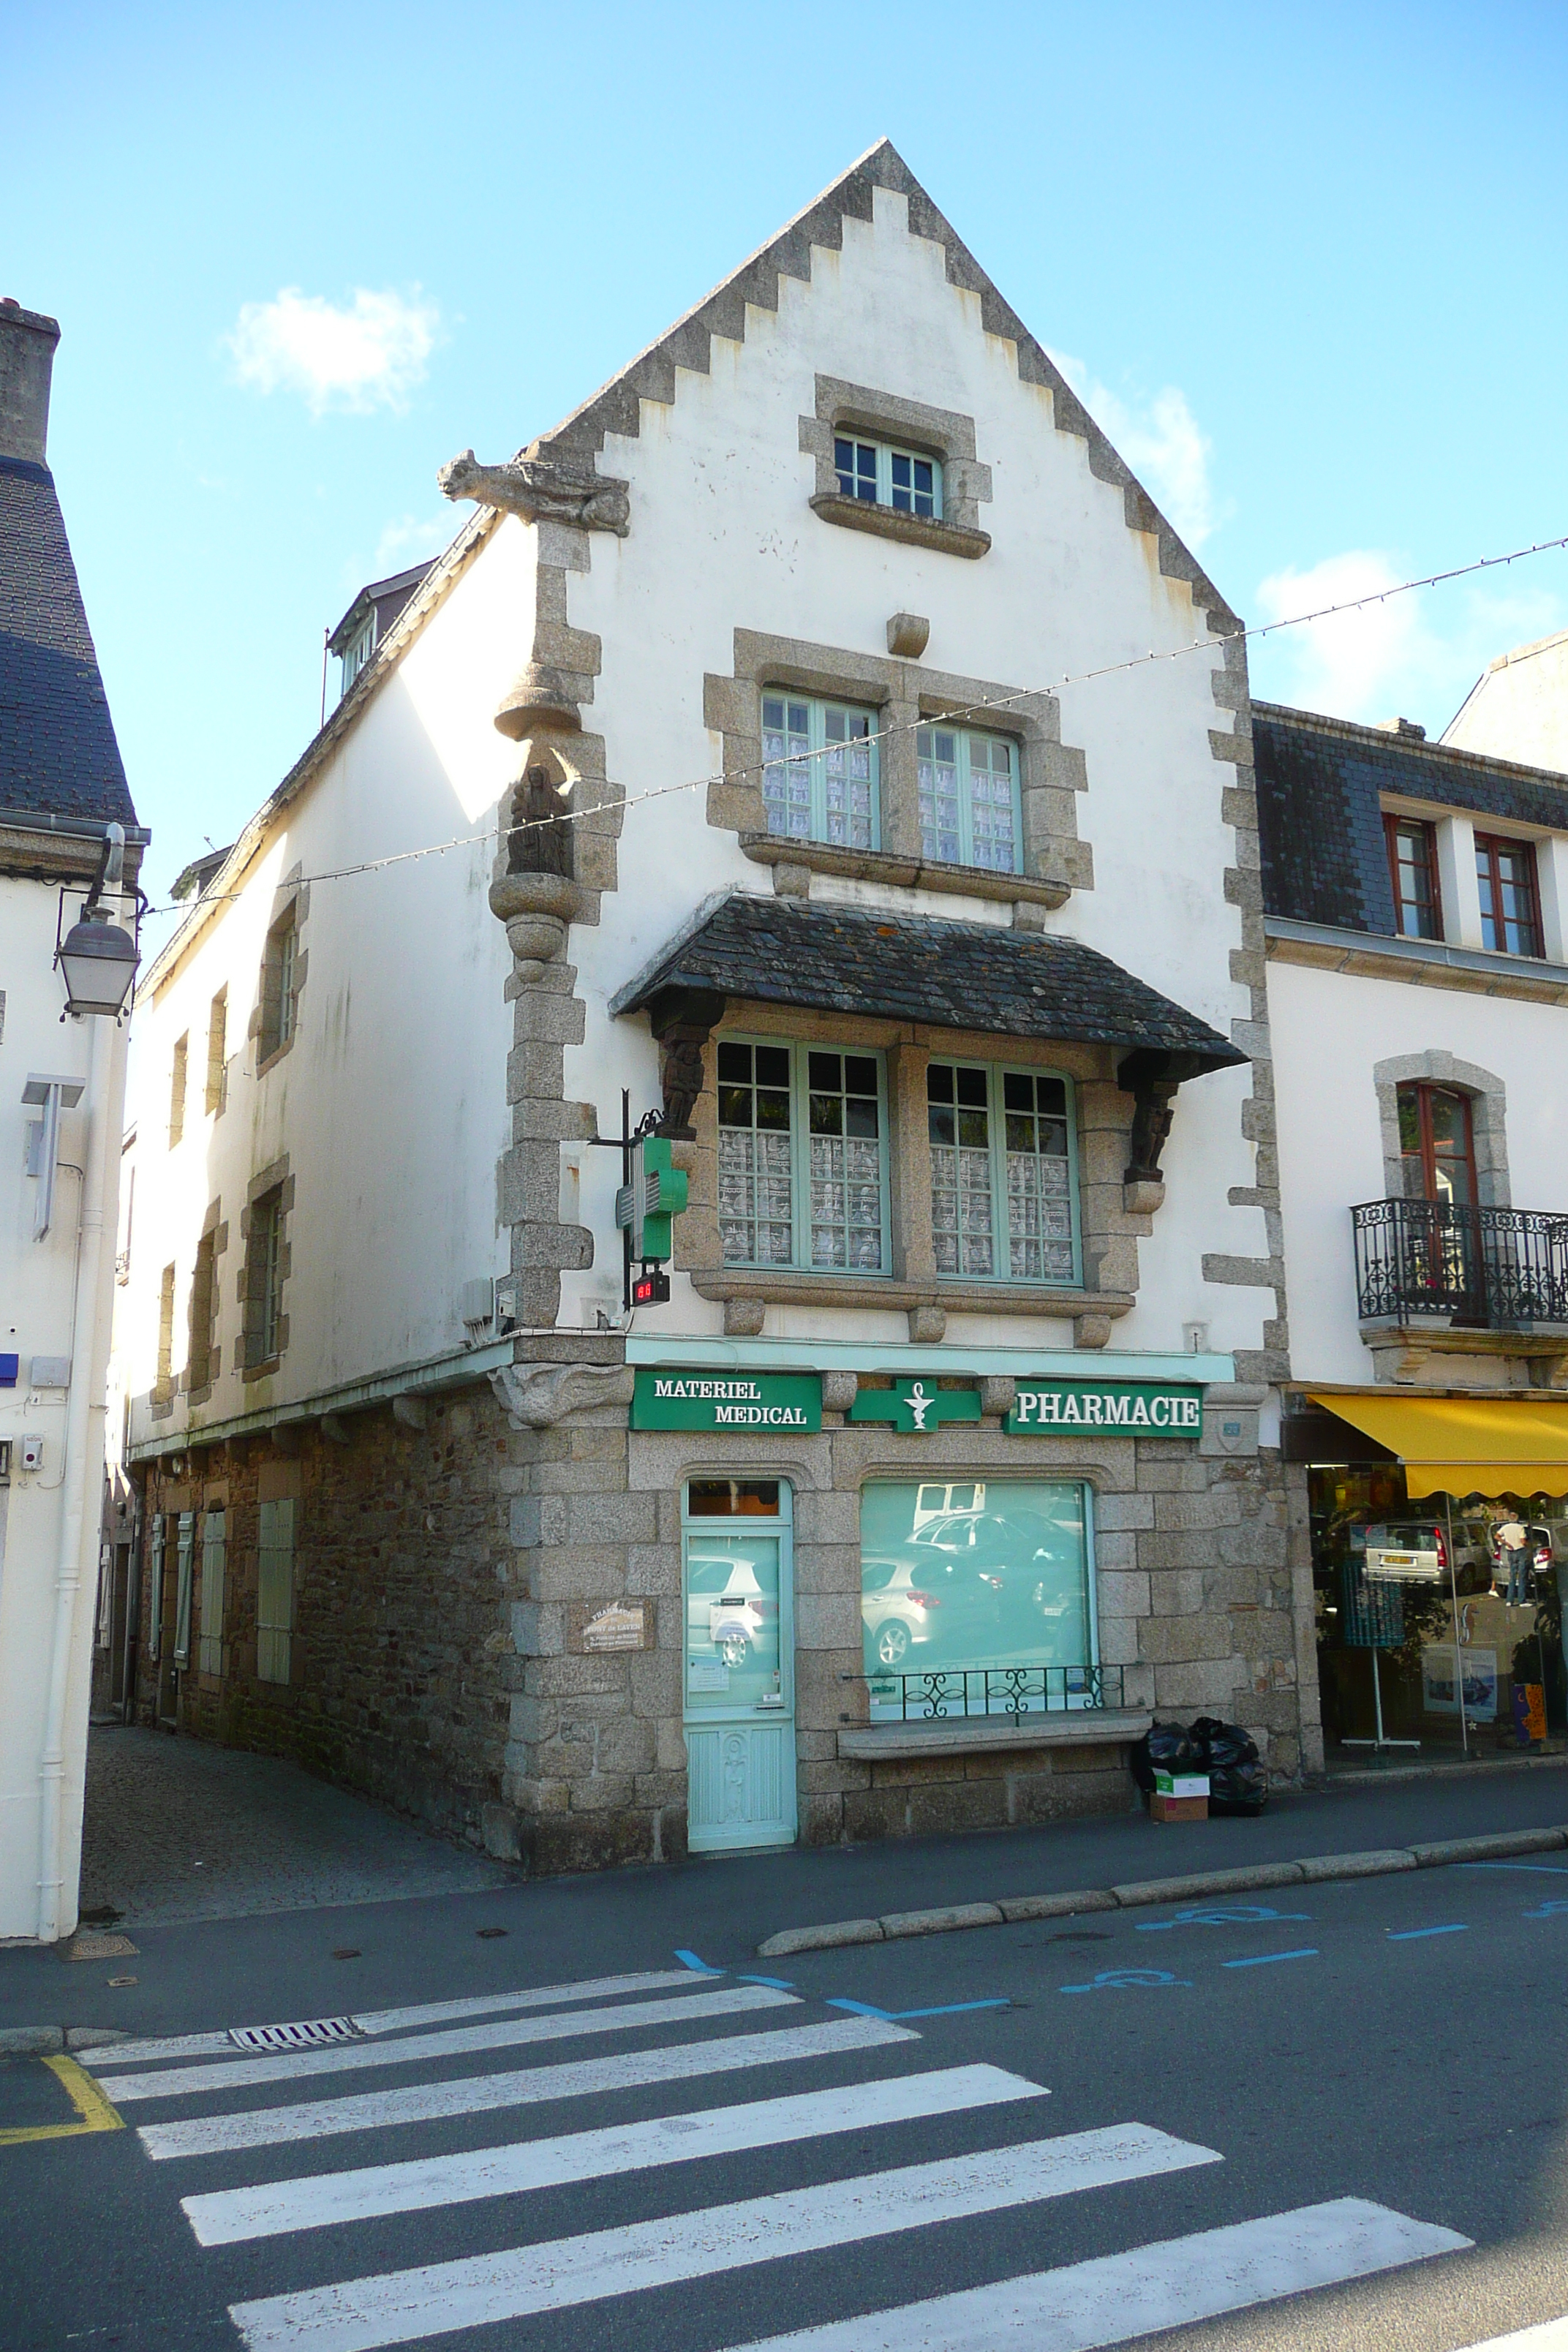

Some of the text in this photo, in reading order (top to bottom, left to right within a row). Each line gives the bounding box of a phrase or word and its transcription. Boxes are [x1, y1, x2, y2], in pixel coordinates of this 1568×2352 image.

[654, 1379, 761, 1400] MATERIEL
[714, 1406, 807, 1425] MEDICAL
[1017, 1392, 1200, 1427] PHARMACIE
